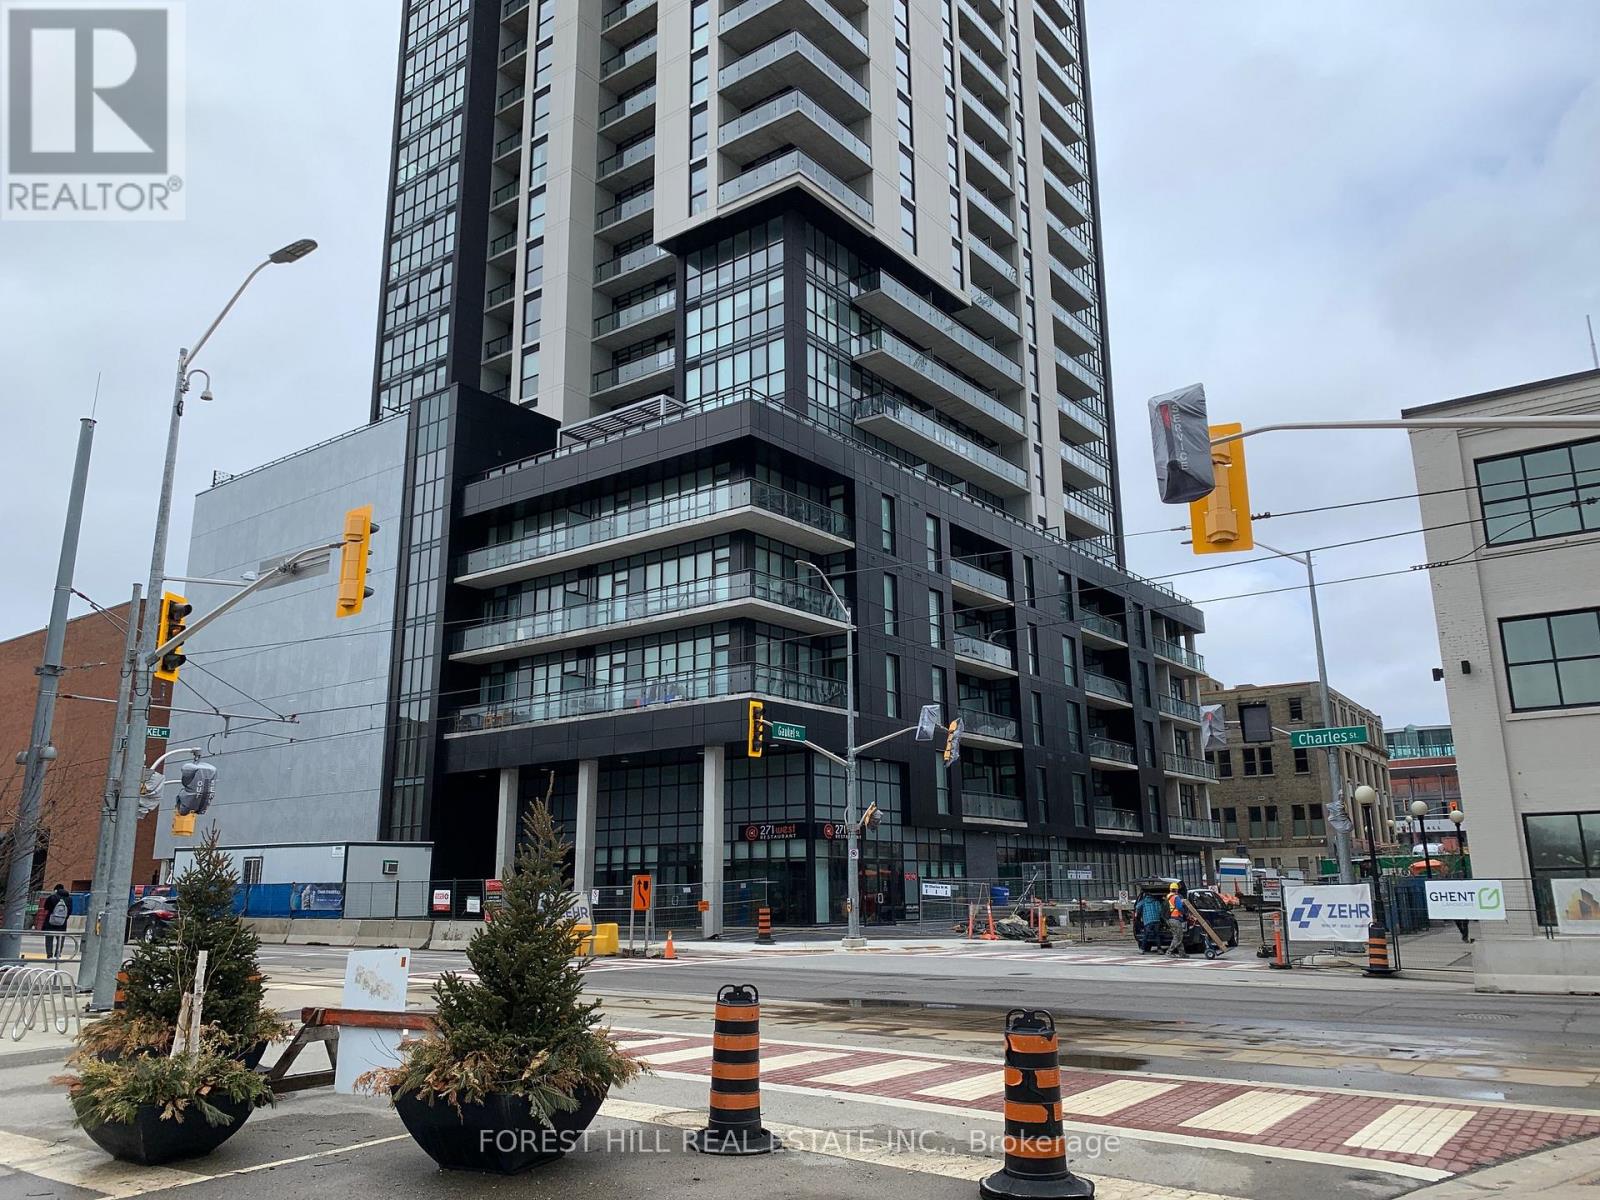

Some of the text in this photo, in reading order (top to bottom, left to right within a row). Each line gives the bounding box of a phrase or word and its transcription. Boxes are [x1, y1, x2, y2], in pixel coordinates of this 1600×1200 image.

[1171, 404, 1189, 470] SERVICE
[778, 726, 796, 738] Gaukel
[1298, 731, 1348, 745] Charles
[760, 825, 775, 835] 271
[835, 824, 846, 835] 271
[1429, 891, 1476, 902] GHENT
[1327, 903, 1371, 919] ZEHR
